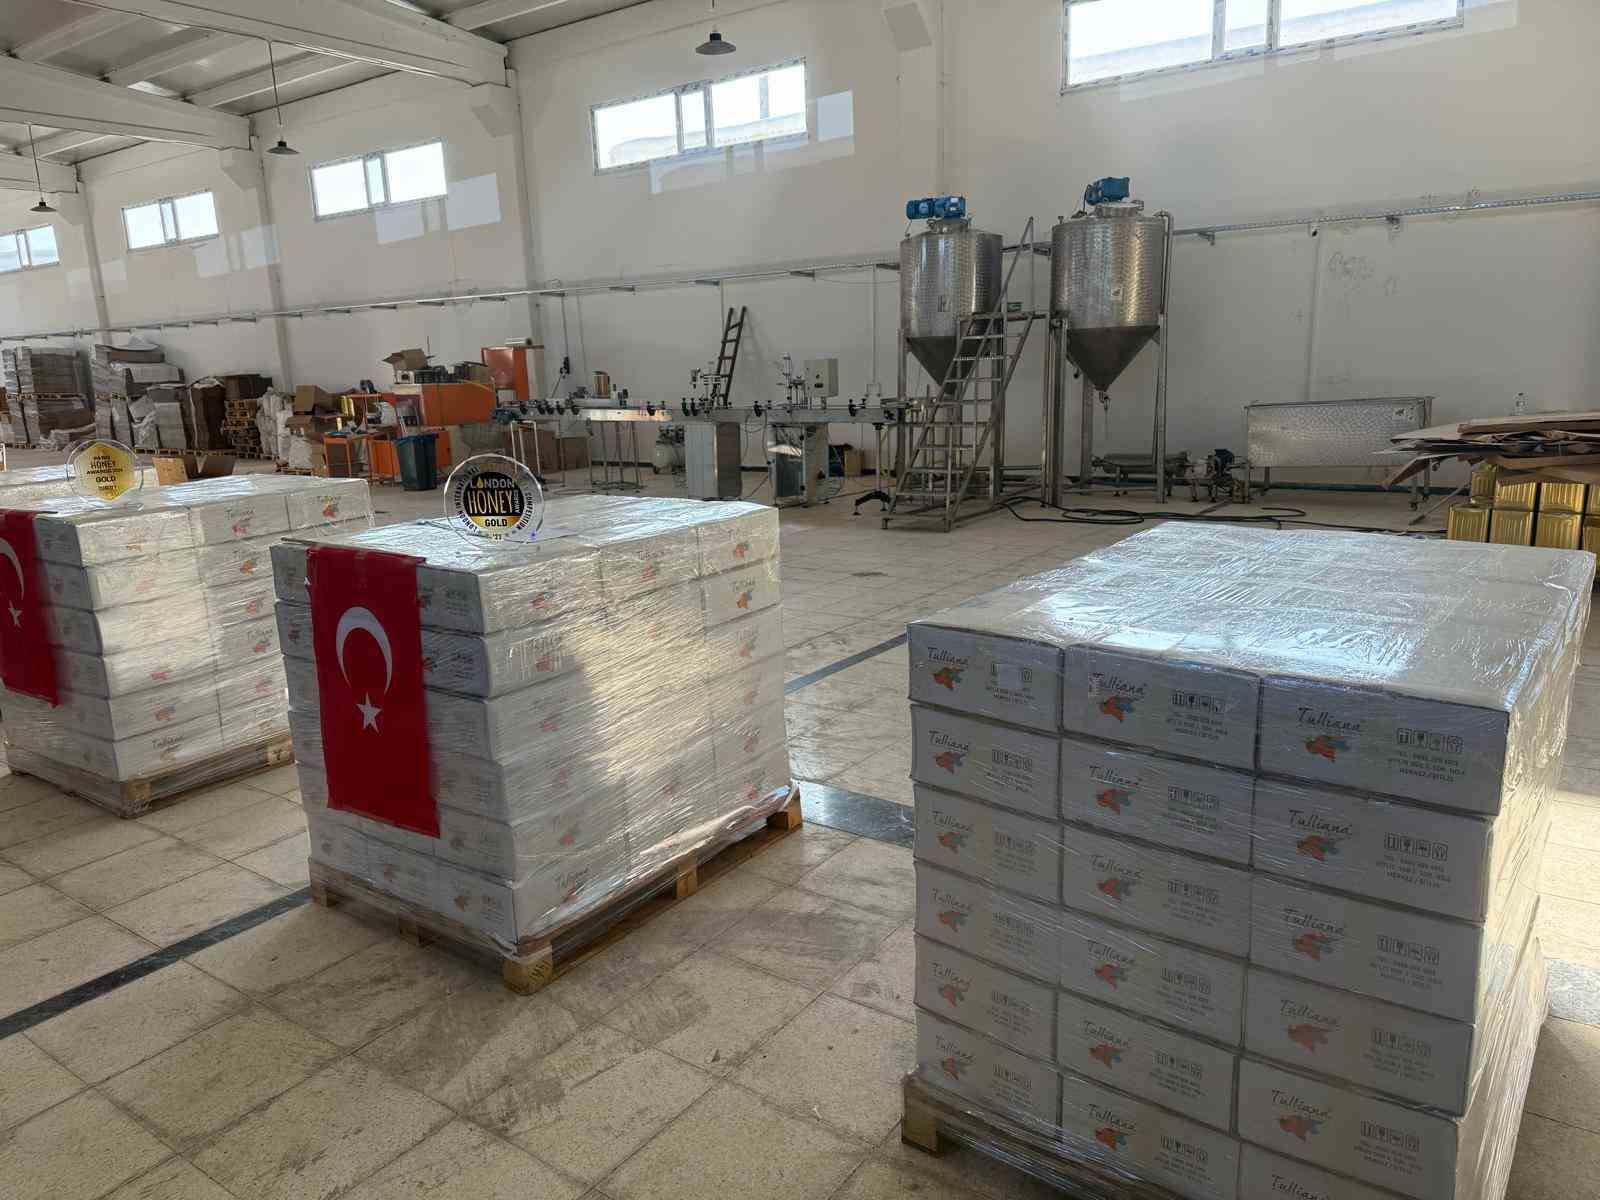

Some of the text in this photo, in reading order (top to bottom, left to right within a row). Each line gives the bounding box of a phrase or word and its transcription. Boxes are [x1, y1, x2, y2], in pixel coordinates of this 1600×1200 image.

[95, 475, 116, 483] GOLD
[470, 477, 516, 489] LONDON
[467, 488, 513, 515] HONEY
[484, 518, 508, 527] GOLD
